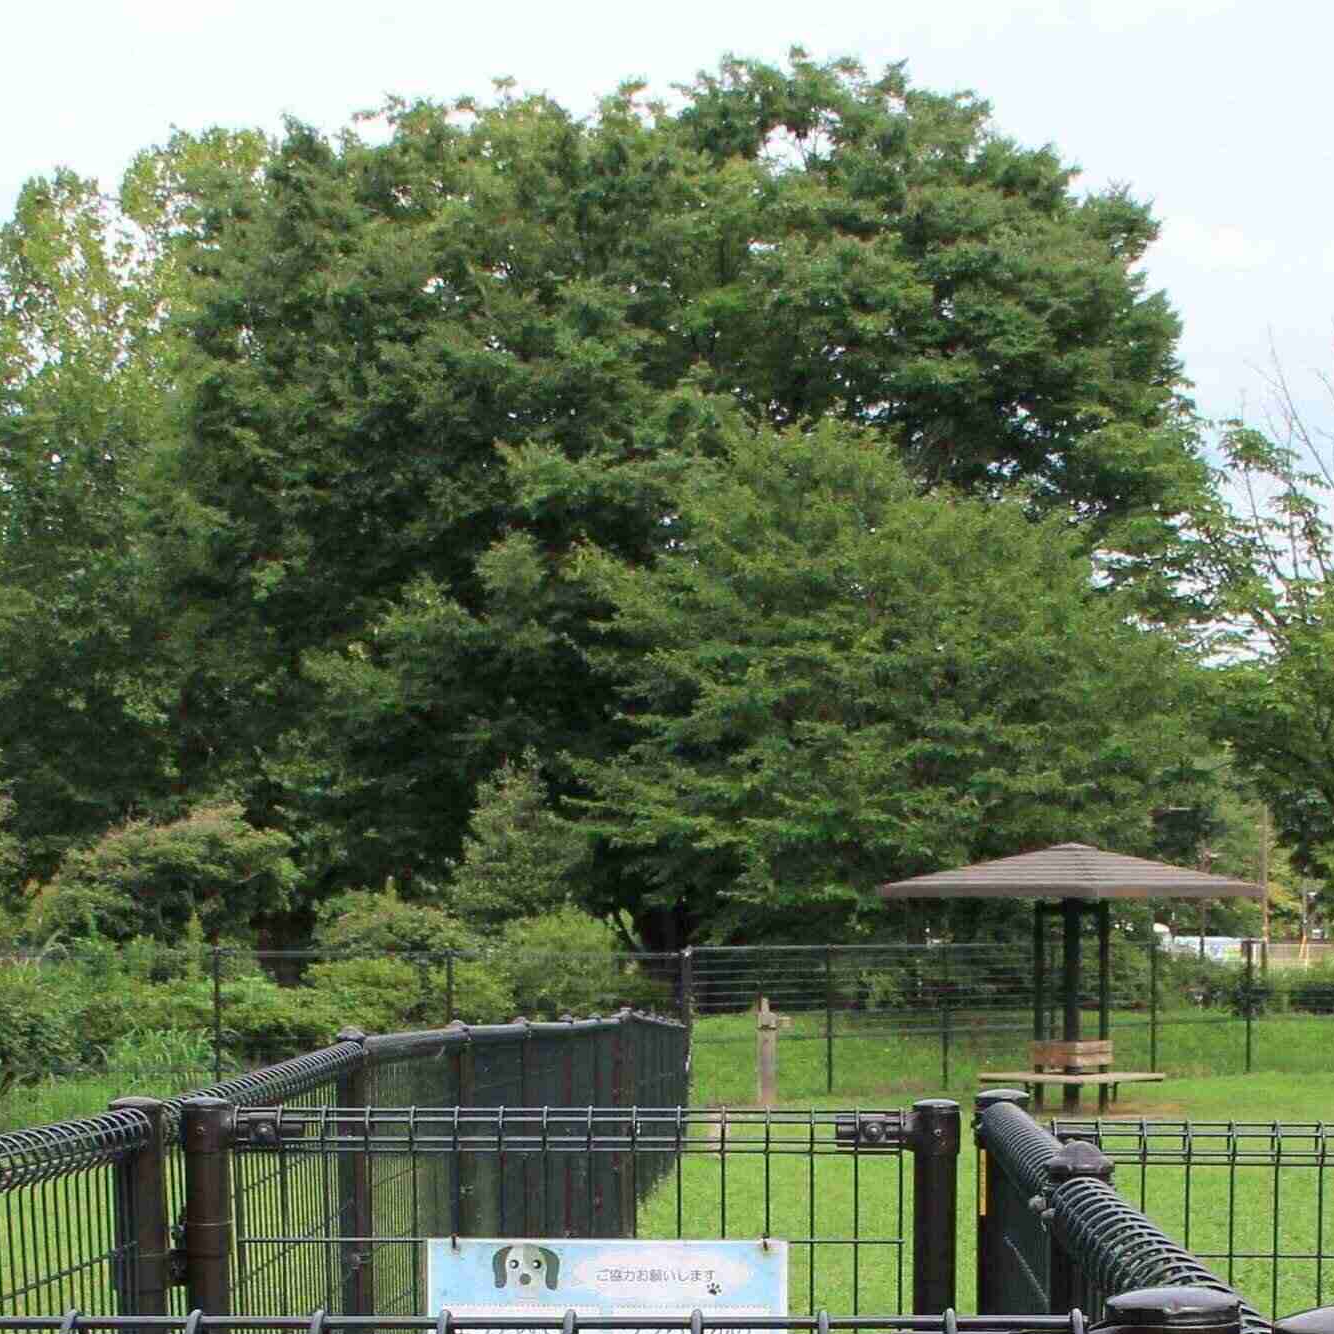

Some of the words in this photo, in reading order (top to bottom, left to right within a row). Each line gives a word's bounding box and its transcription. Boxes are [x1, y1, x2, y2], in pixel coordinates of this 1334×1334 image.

[595, 1268, 716, 1283] ご協力お願いします
